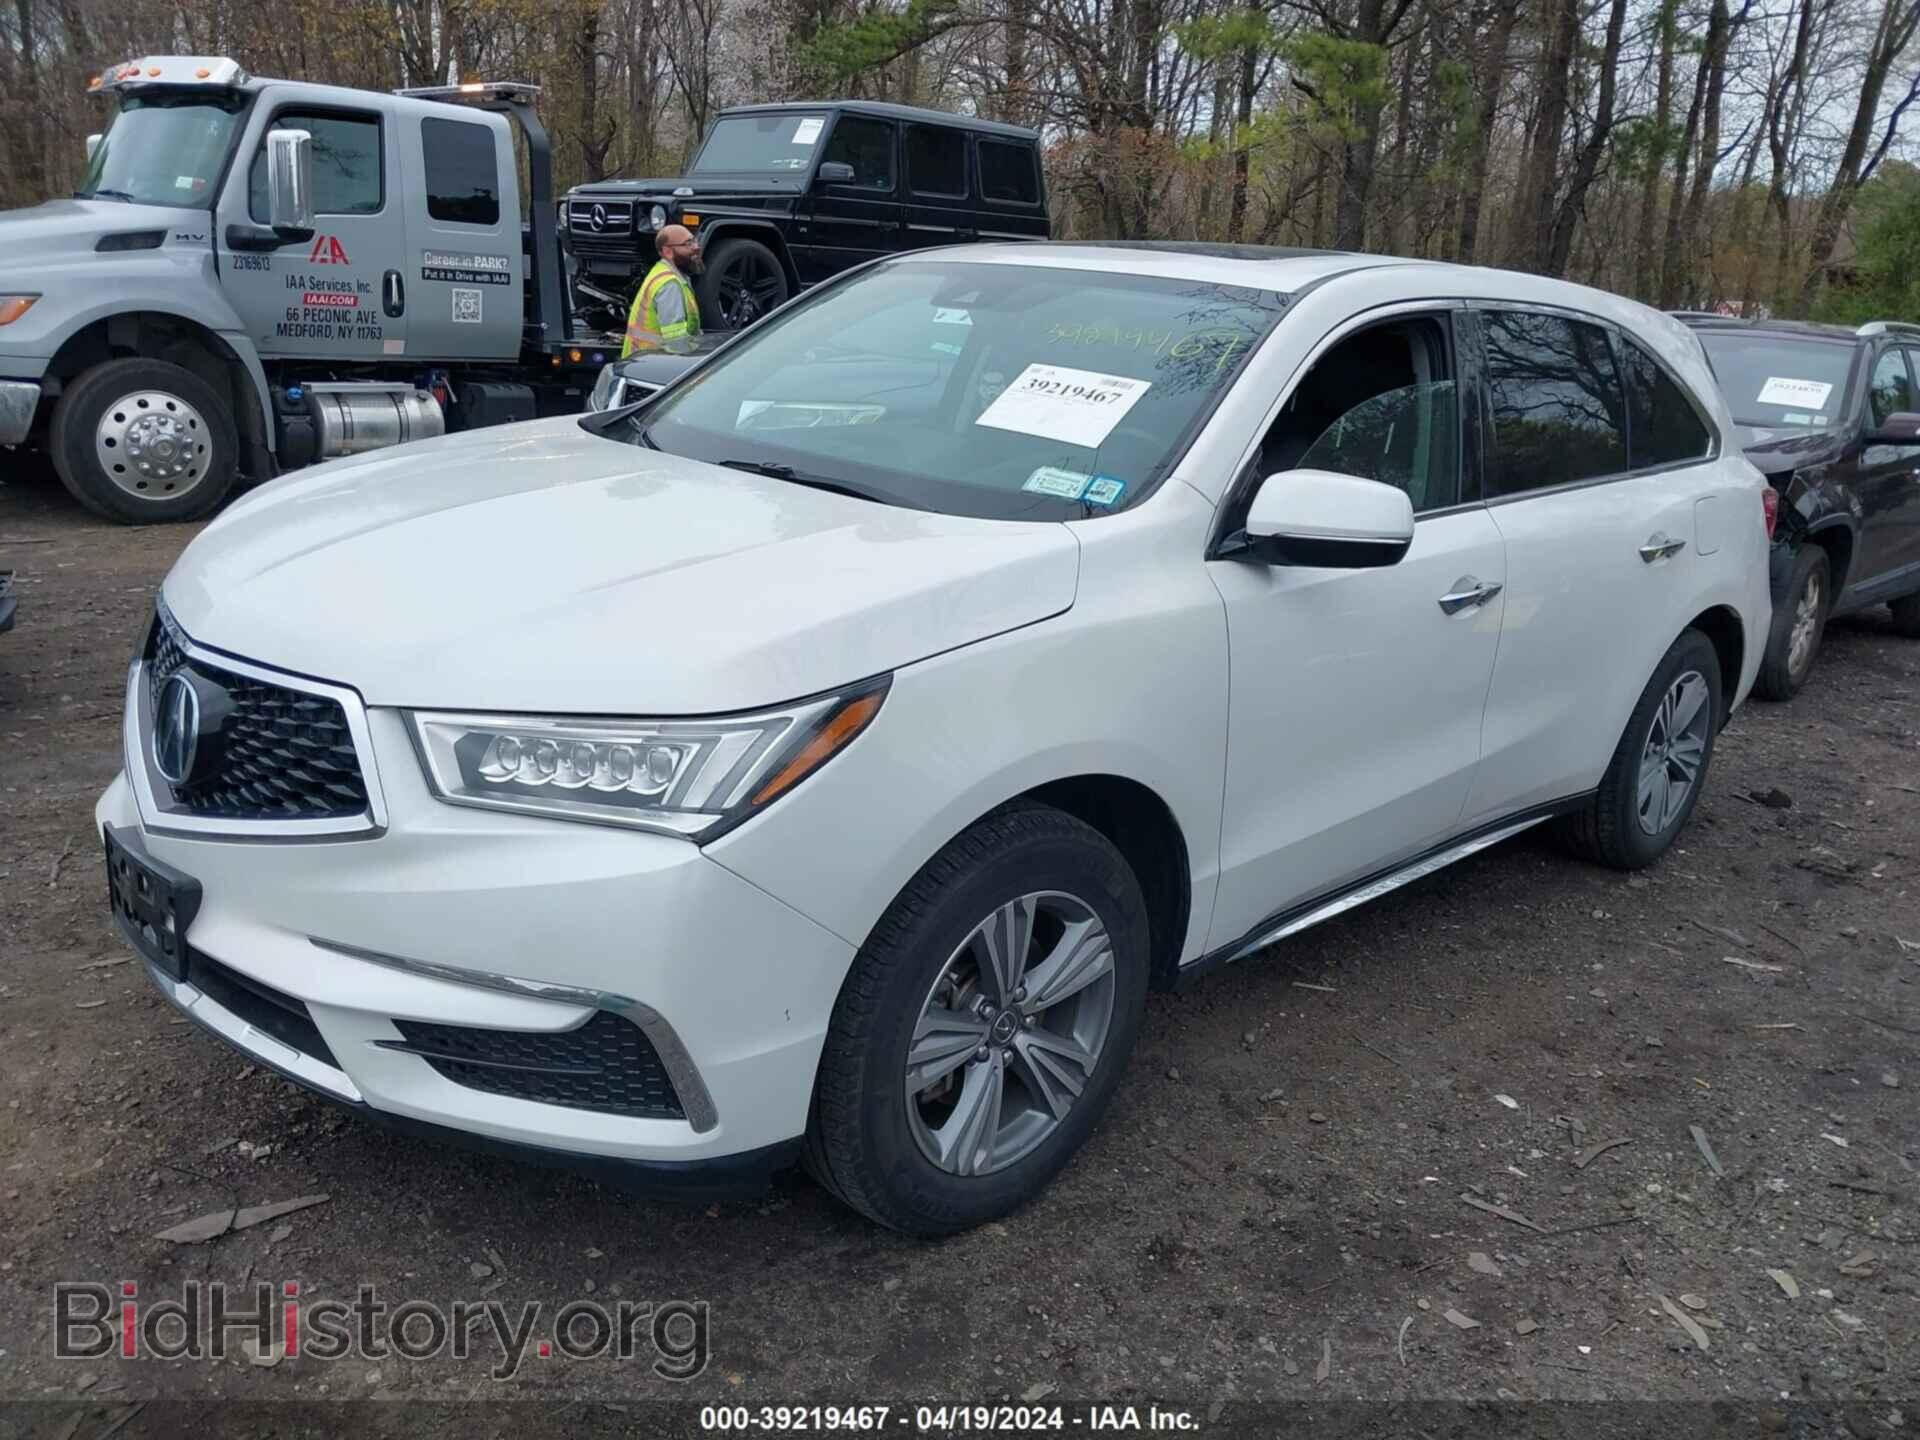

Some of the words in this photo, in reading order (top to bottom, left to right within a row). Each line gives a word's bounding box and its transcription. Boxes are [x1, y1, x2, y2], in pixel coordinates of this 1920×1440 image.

[424, 251, 458, 266] Career
[474, 256, 508, 270] PARK?
[286, 274, 306, 289] IAA
[357, 279, 374, 294] Inc.
[286, 308, 300, 322] 66
[304, 308, 351, 324] PECONIC
[356, 311, 377, 325] AVE
[276, 323, 335, 340] MEDFORD,
[338, 326, 354, 339] NY
[357, 326, 383, 340] 11763
[1022, 377, 1124, 405] 39219467
